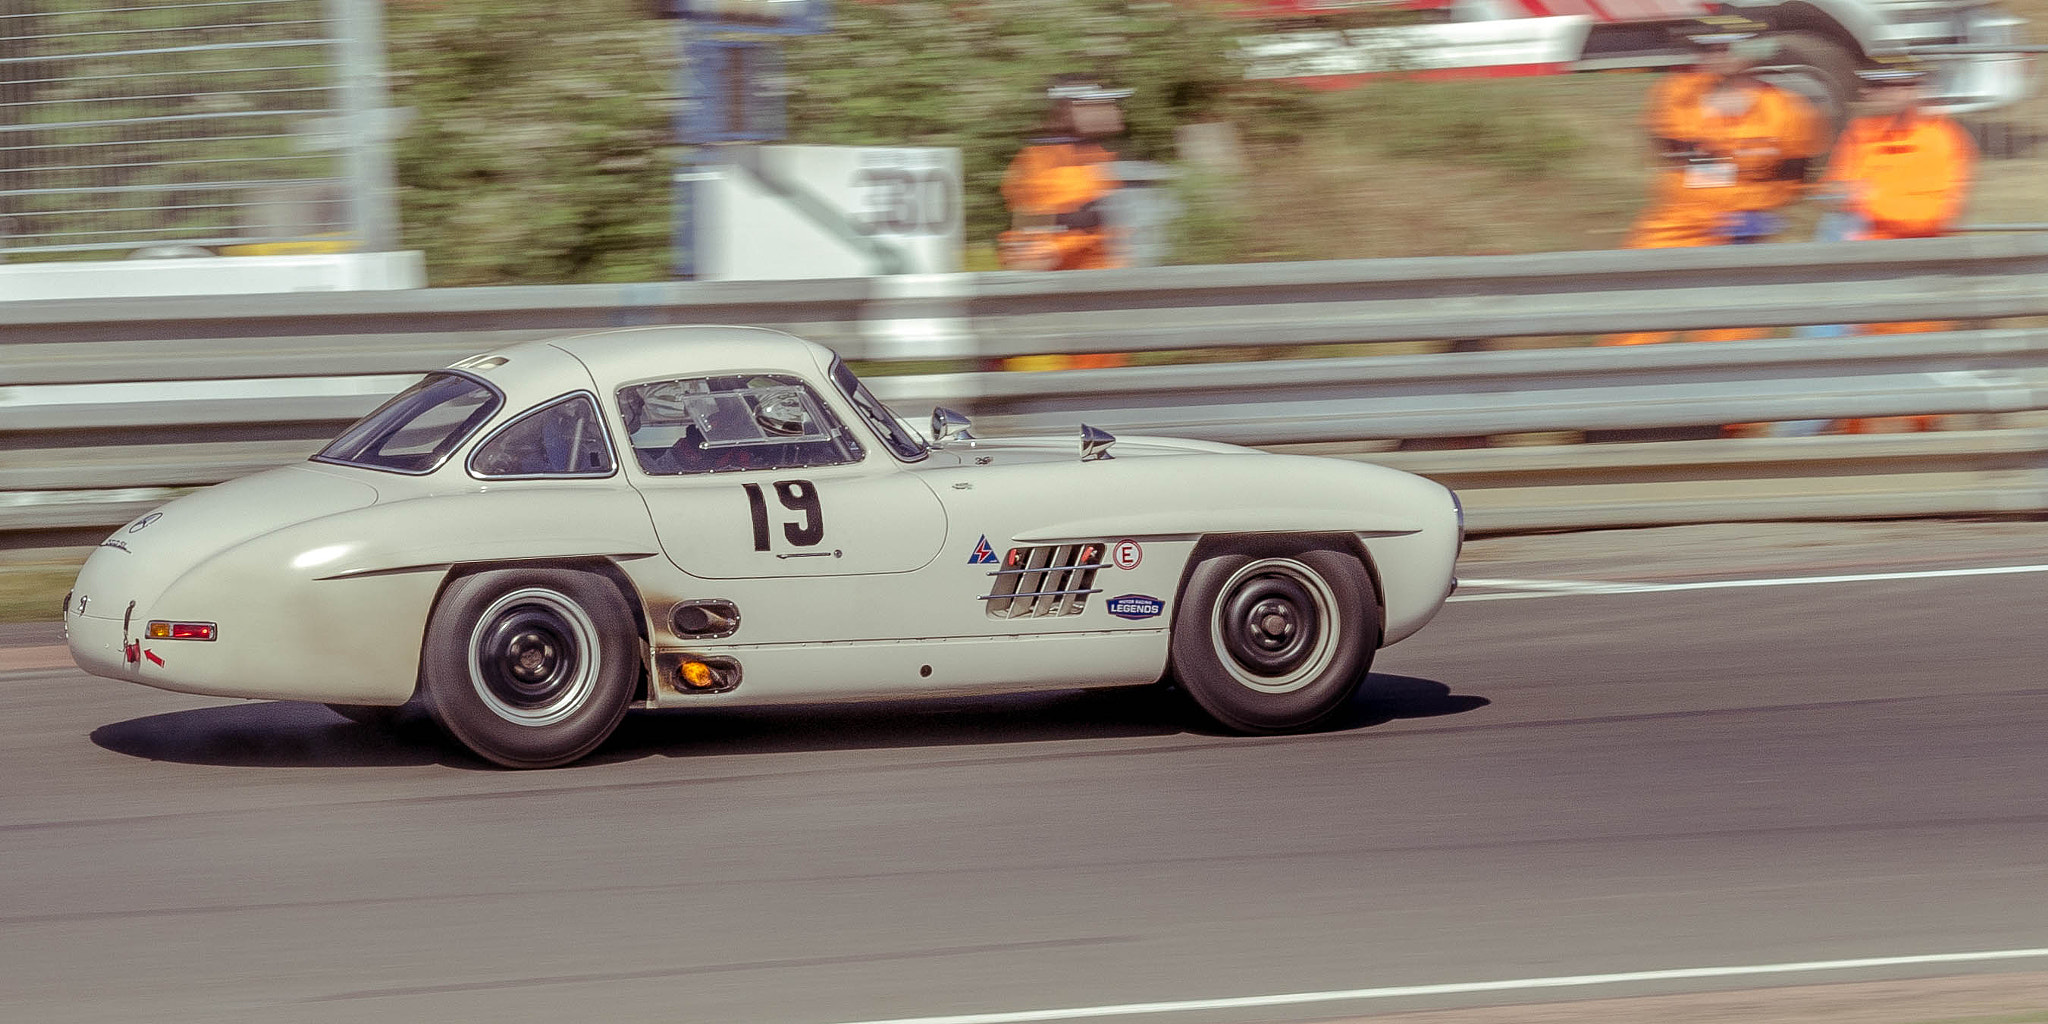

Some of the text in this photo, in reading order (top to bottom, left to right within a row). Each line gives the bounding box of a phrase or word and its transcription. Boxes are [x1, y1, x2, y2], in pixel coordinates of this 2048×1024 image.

[742, 479, 824, 551] 19
[1122, 546, 1133, 563] E
[1111, 605, 1159, 614] LEGENDS
